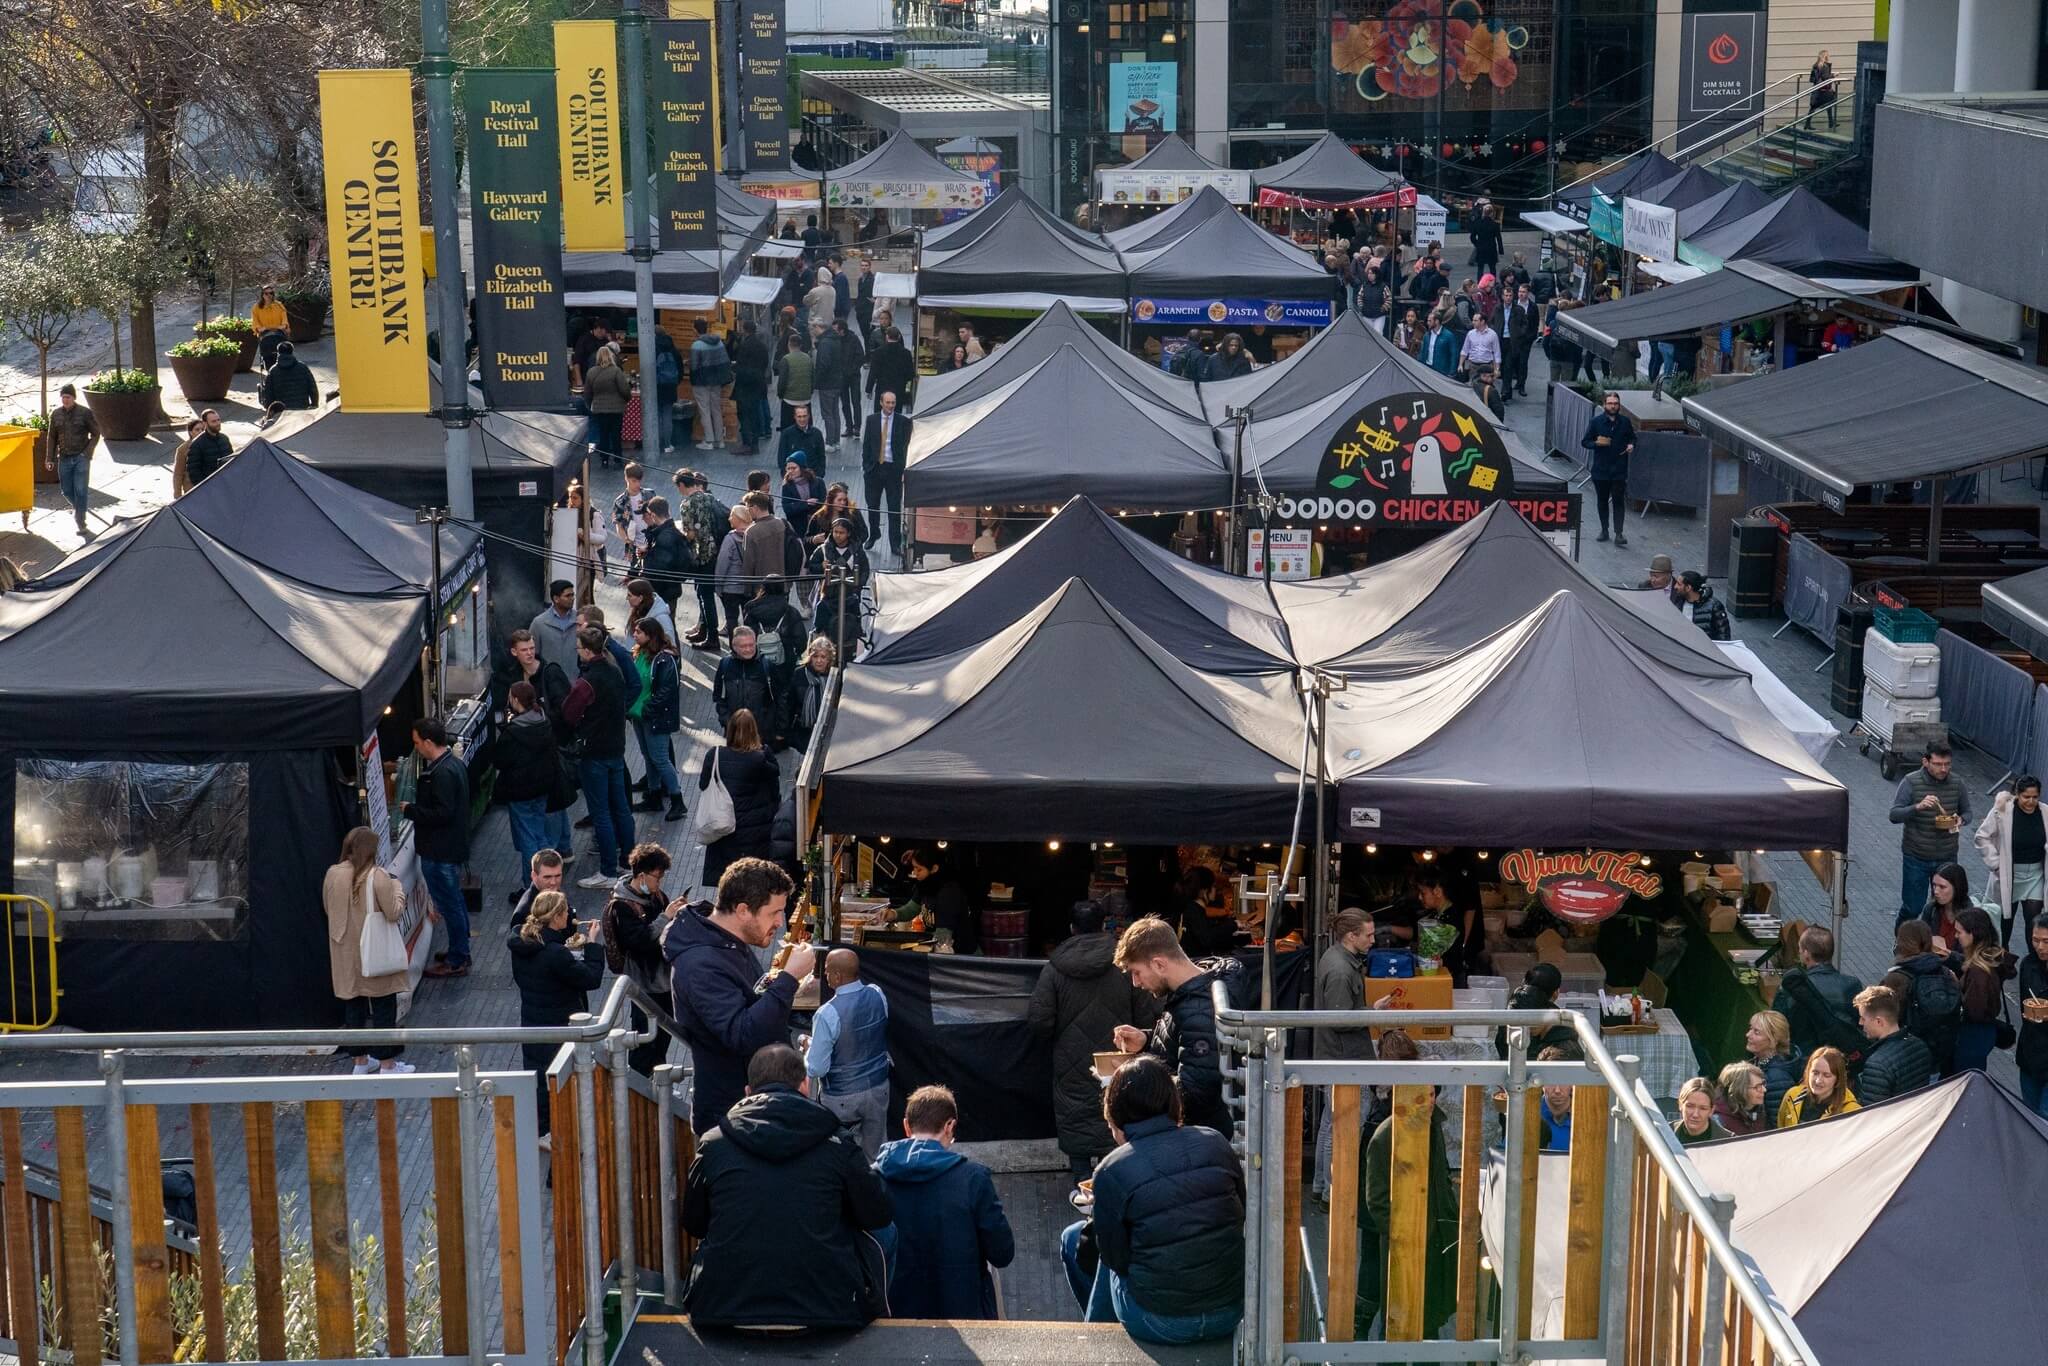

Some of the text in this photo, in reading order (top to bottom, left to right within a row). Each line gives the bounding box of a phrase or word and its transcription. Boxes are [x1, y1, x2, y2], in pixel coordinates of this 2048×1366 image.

[753, 12, 774, 22] Royal
[750, 21, 777, 29] Festival
[756, 30, 772, 38] Hall
[668, 40, 695, 53] Royal
[663, 51, 700, 61] Festival
[672, 63, 693, 73] Hall
[748, 59, 781, 68] Hayward
[752, 68, 778, 76] Gallery
[753, 96, 778, 104] Queen
[490, 100, 531, 117] Royal
[662, 101, 705, 113] Hayward
[749, 104, 783, 112] Elizabeth
[484, 117, 539, 131] Festival
[667, 113, 701, 124] Gallery
[497, 134, 528, 148] Hall
[569, 94, 590, 181] CENTRE
[588, 67, 612, 206] SOUTHBANK
[670, 151, 701, 161] Queen
[756, 149, 779, 157] Room
[664, 161, 708, 171] Elizabeth
[676, 173, 697, 182] Hall
[844, 182, 967, 193] TOASTIE BRUSCHETTA WRAPS
[483, 191, 547, 207] Hayward
[489, 208, 542, 223] Gallery
[671, 210, 705, 220] Purcell
[674, 221, 703, 231] Room
[1648, 218, 1671, 241] WINE
[344, 180, 376, 308] CENTRE
[372, 140, 409, 345] SOUTHBANK
[494, 264, 542, 280] Queen
[486, 280, 553, 293] Elizabeth
[505, 296, 535, 310] Hall
[1157, 307, 1328, 317] ARANCINI PASTA CANNOLI
[496, 352, 548, 365] Purcell
[501, 369, 545, 381] Room
[1383, 499, 1479, 521] CHICKEN
[1509, 500, 1568, 523] PICE
[1502, 848, 1663, 898] Yum Thai
